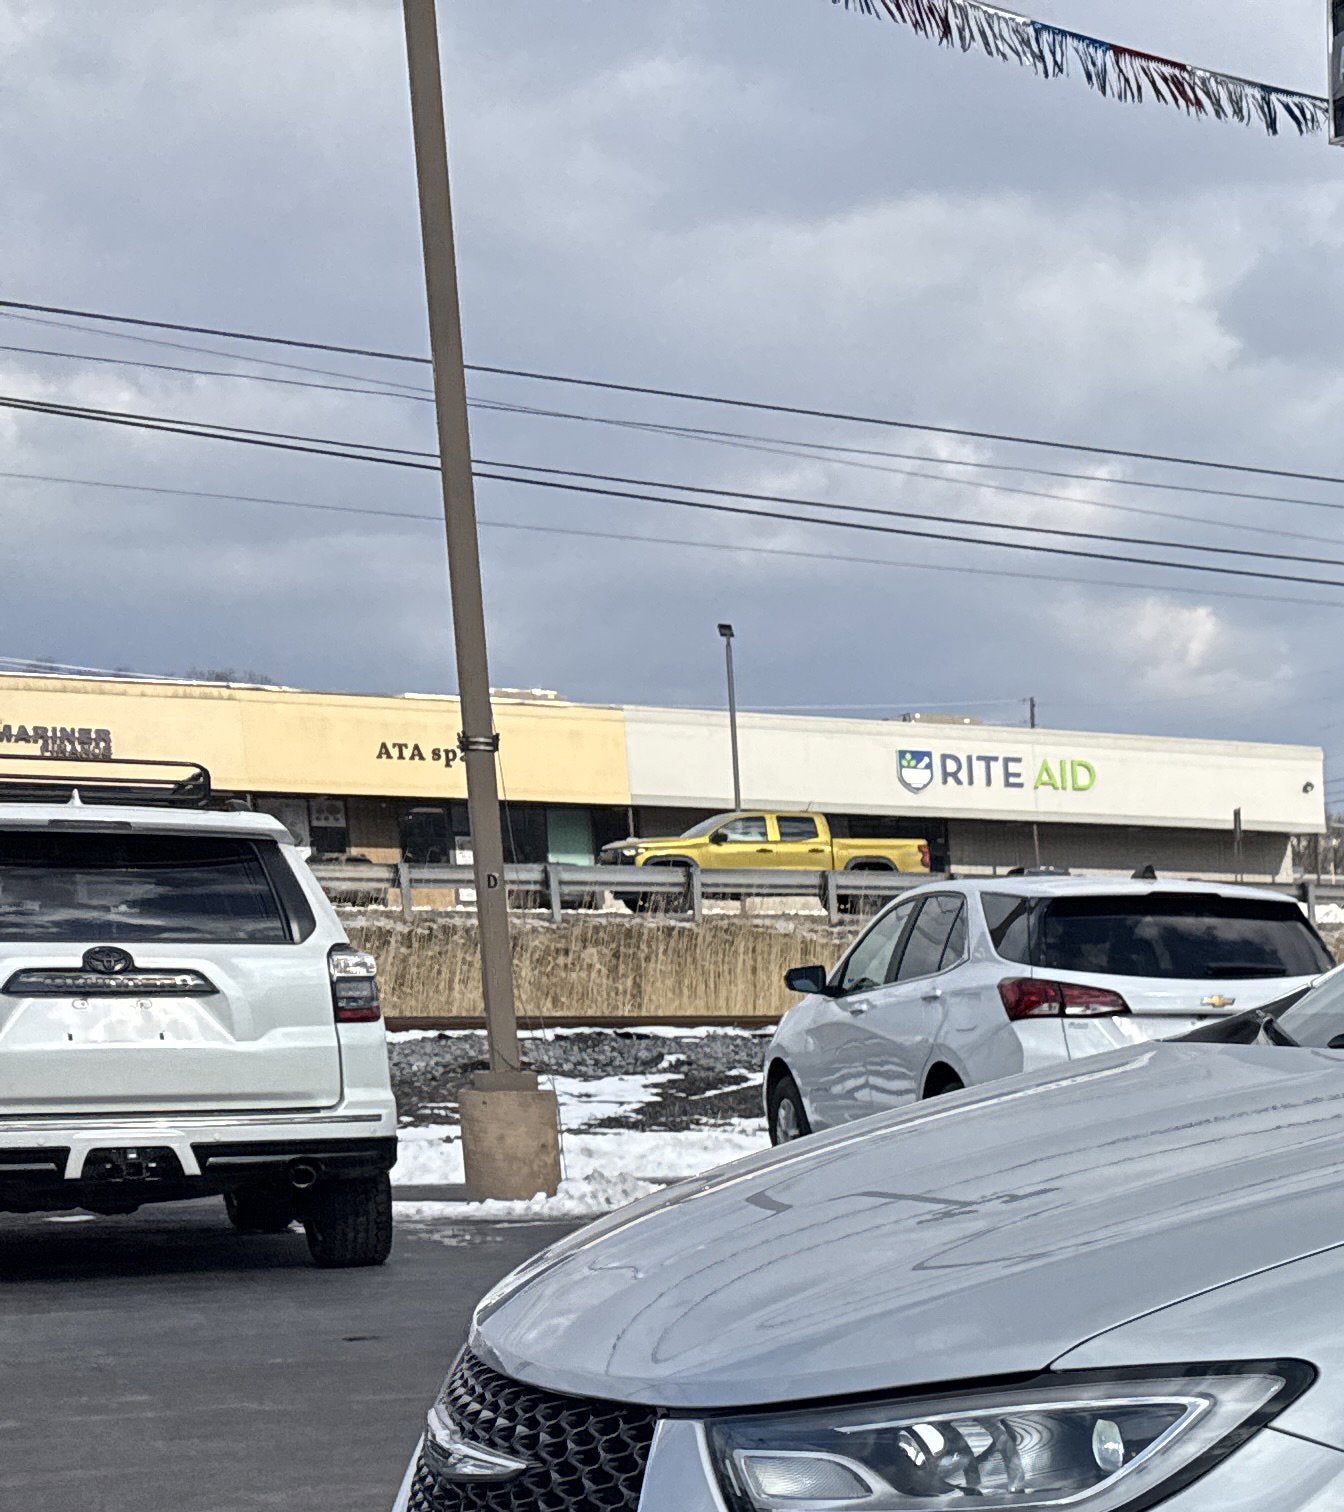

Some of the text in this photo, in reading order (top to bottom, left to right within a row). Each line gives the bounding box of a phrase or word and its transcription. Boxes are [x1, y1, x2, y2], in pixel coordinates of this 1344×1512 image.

[376, 742, 426, 761] ATA
[940, 753, 1097, 792] RITE AID
[487, 873, 498, 889] D
